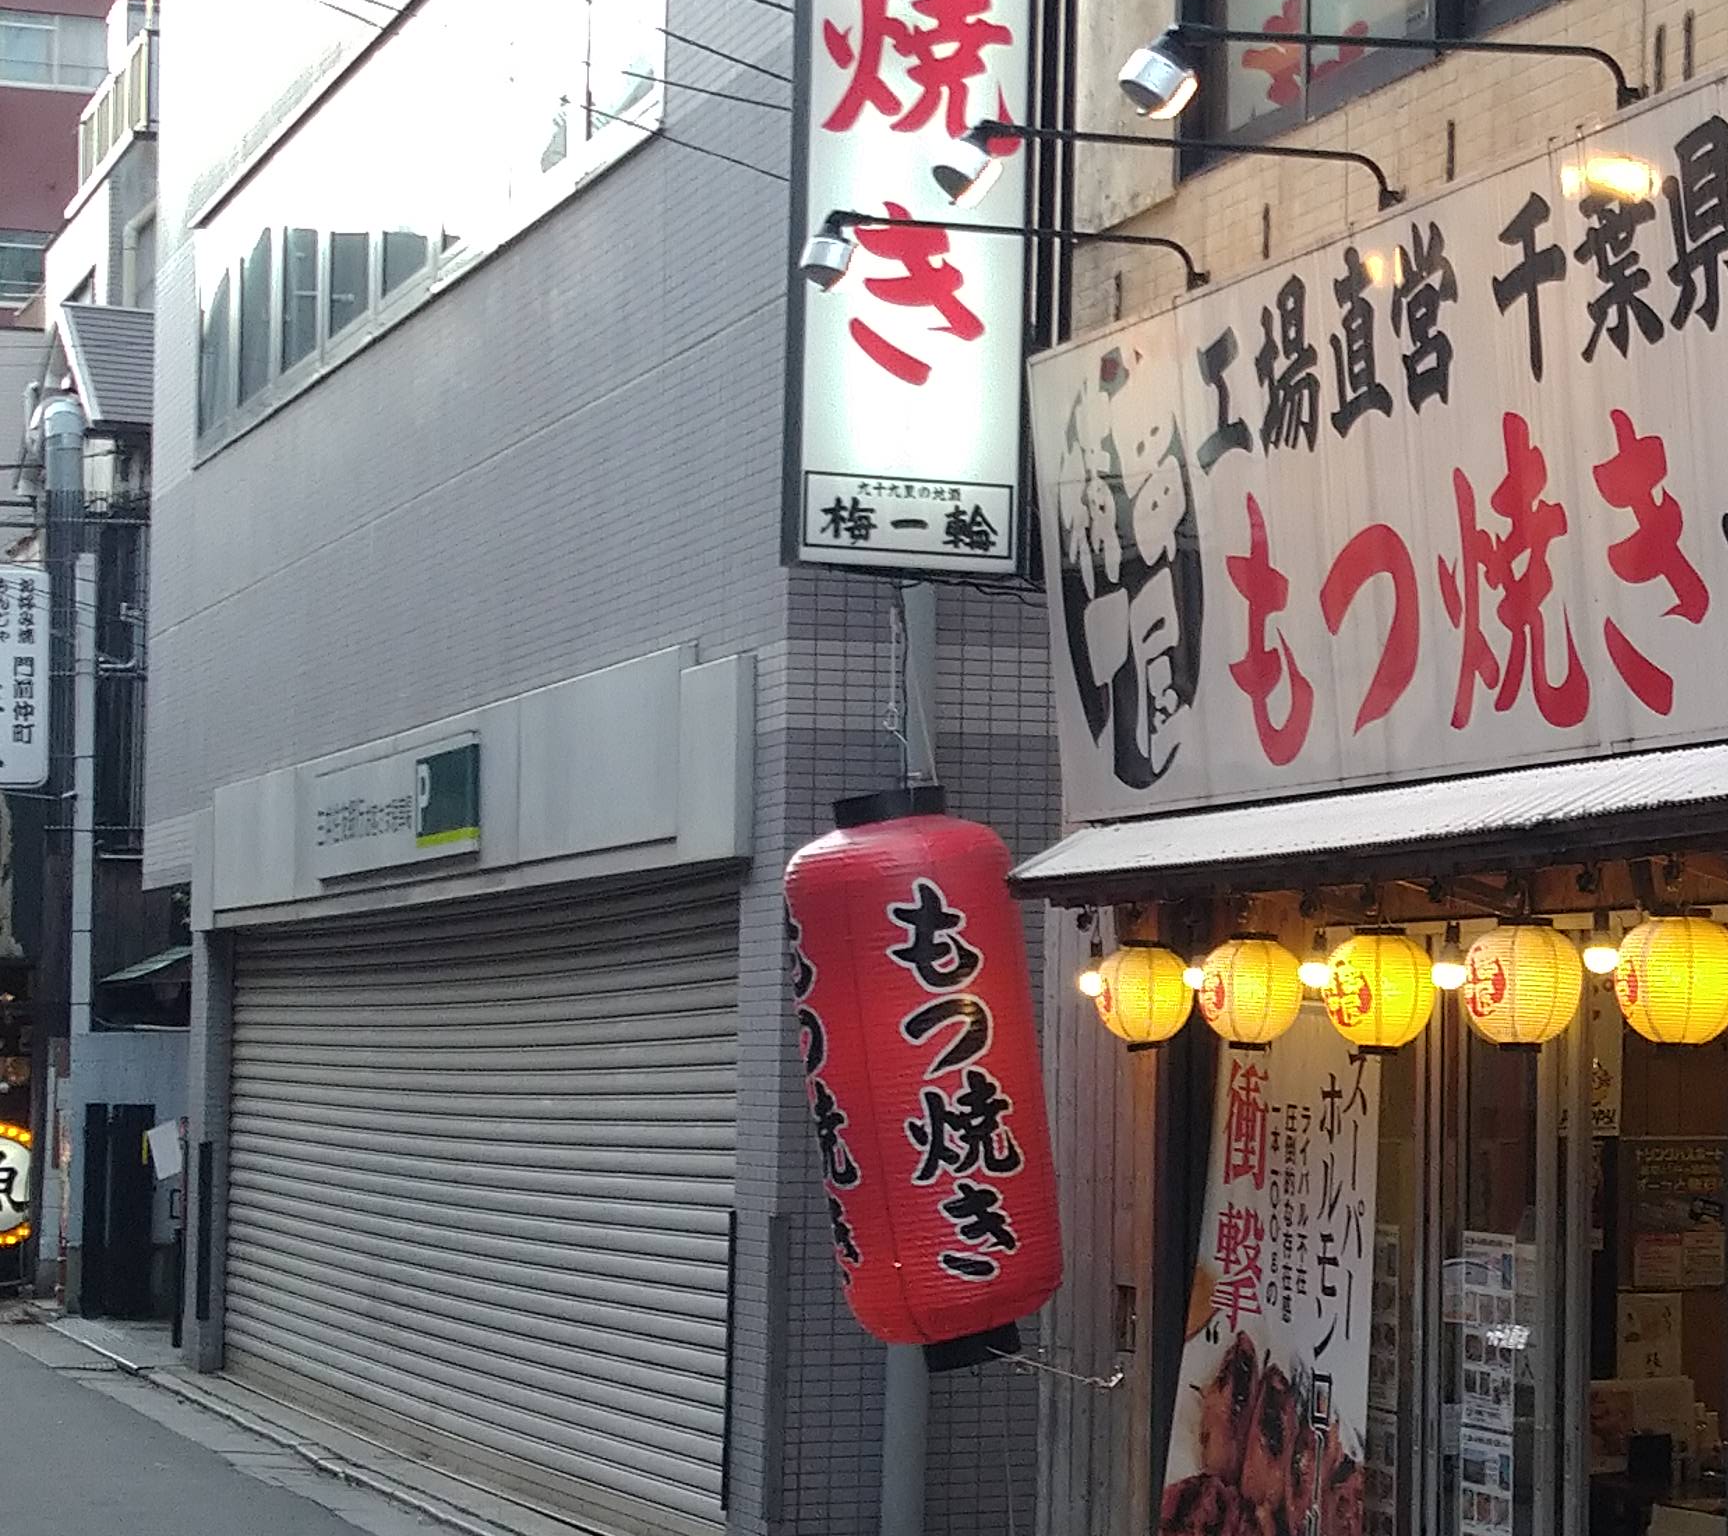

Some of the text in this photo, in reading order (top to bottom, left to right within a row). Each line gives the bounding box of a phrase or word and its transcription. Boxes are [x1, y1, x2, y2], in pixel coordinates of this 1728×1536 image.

[1200, 220, 1458, 472] 工場直営
[819, 496, 999, 553] 梅一輪
[13, 657, 35, 744] 門前仲町
[886, 876, 1025, 1283] もつ焼き
[1341, 1050, 1367, 1340] スーパー
[1312, 1072, 1343, 1361] ホルモン
